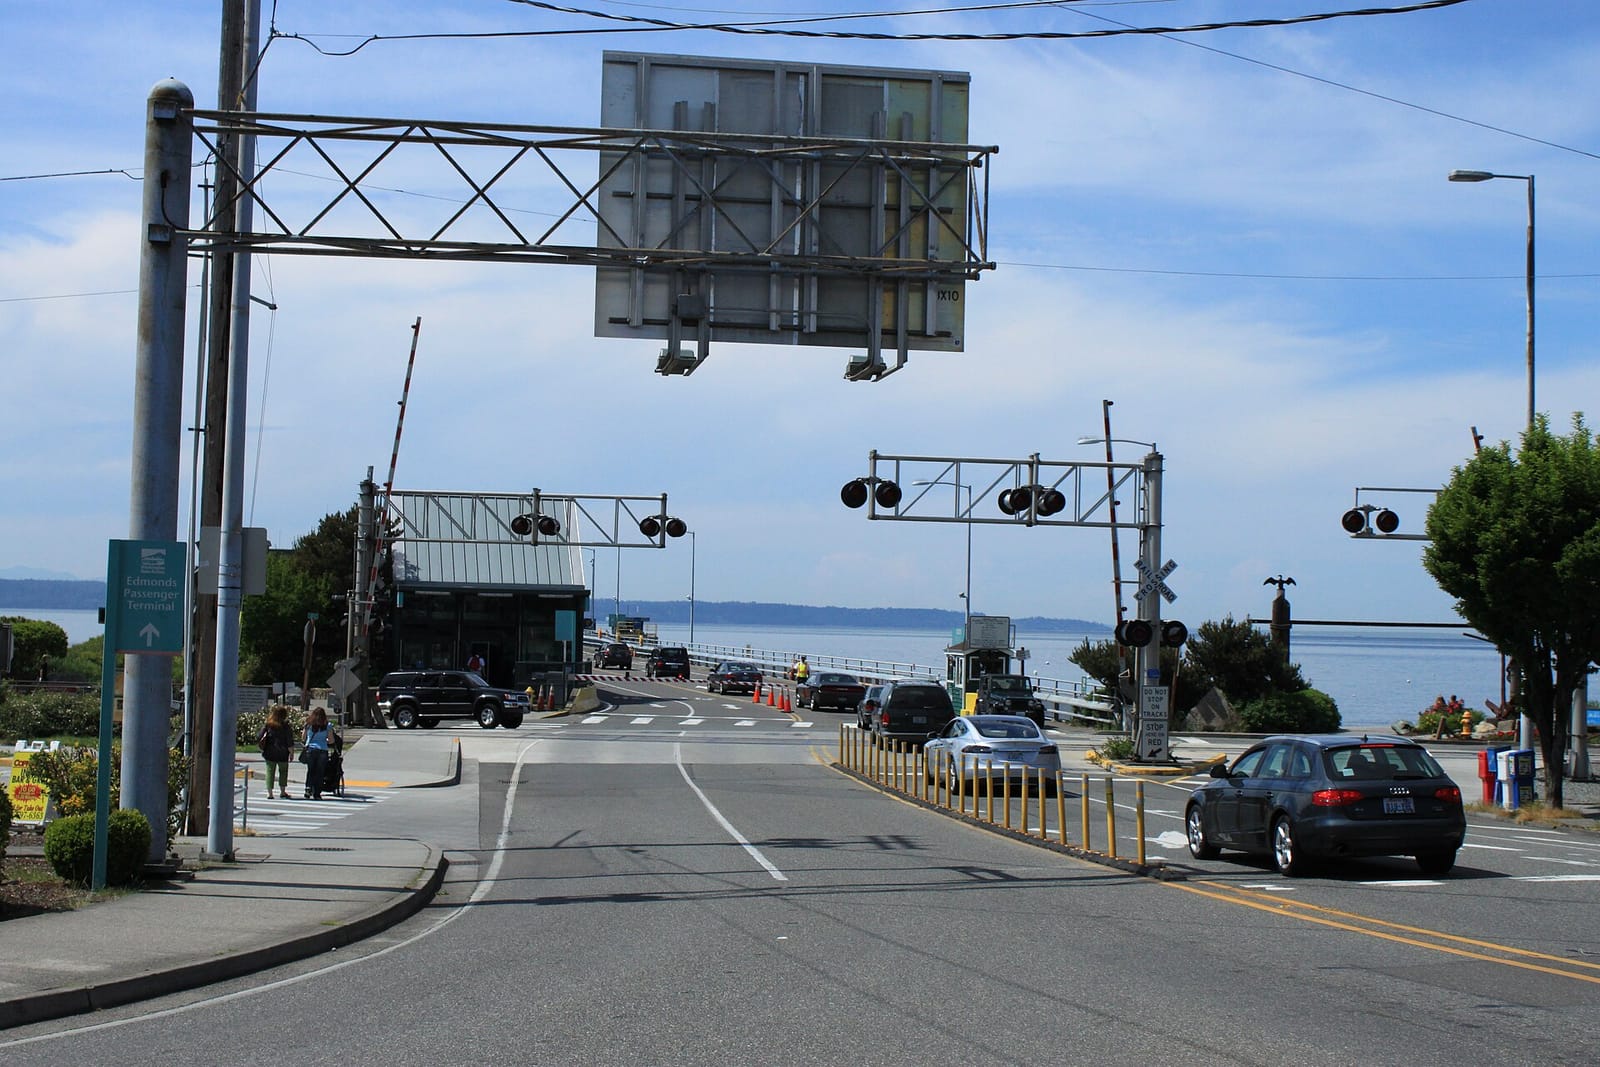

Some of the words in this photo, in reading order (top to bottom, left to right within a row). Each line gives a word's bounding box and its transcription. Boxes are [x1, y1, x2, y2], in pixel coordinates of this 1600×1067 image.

[127, 576, 177, 587] Edmonds
[1135, 560, 1175, 601] RAILROAD
[1135, 560, 1176, 601] CROSSING
[123, 588, 180, 600] Passenger
[128, 601, 175, 611] Terminal
[1147, 738, 1162, 746] RED
